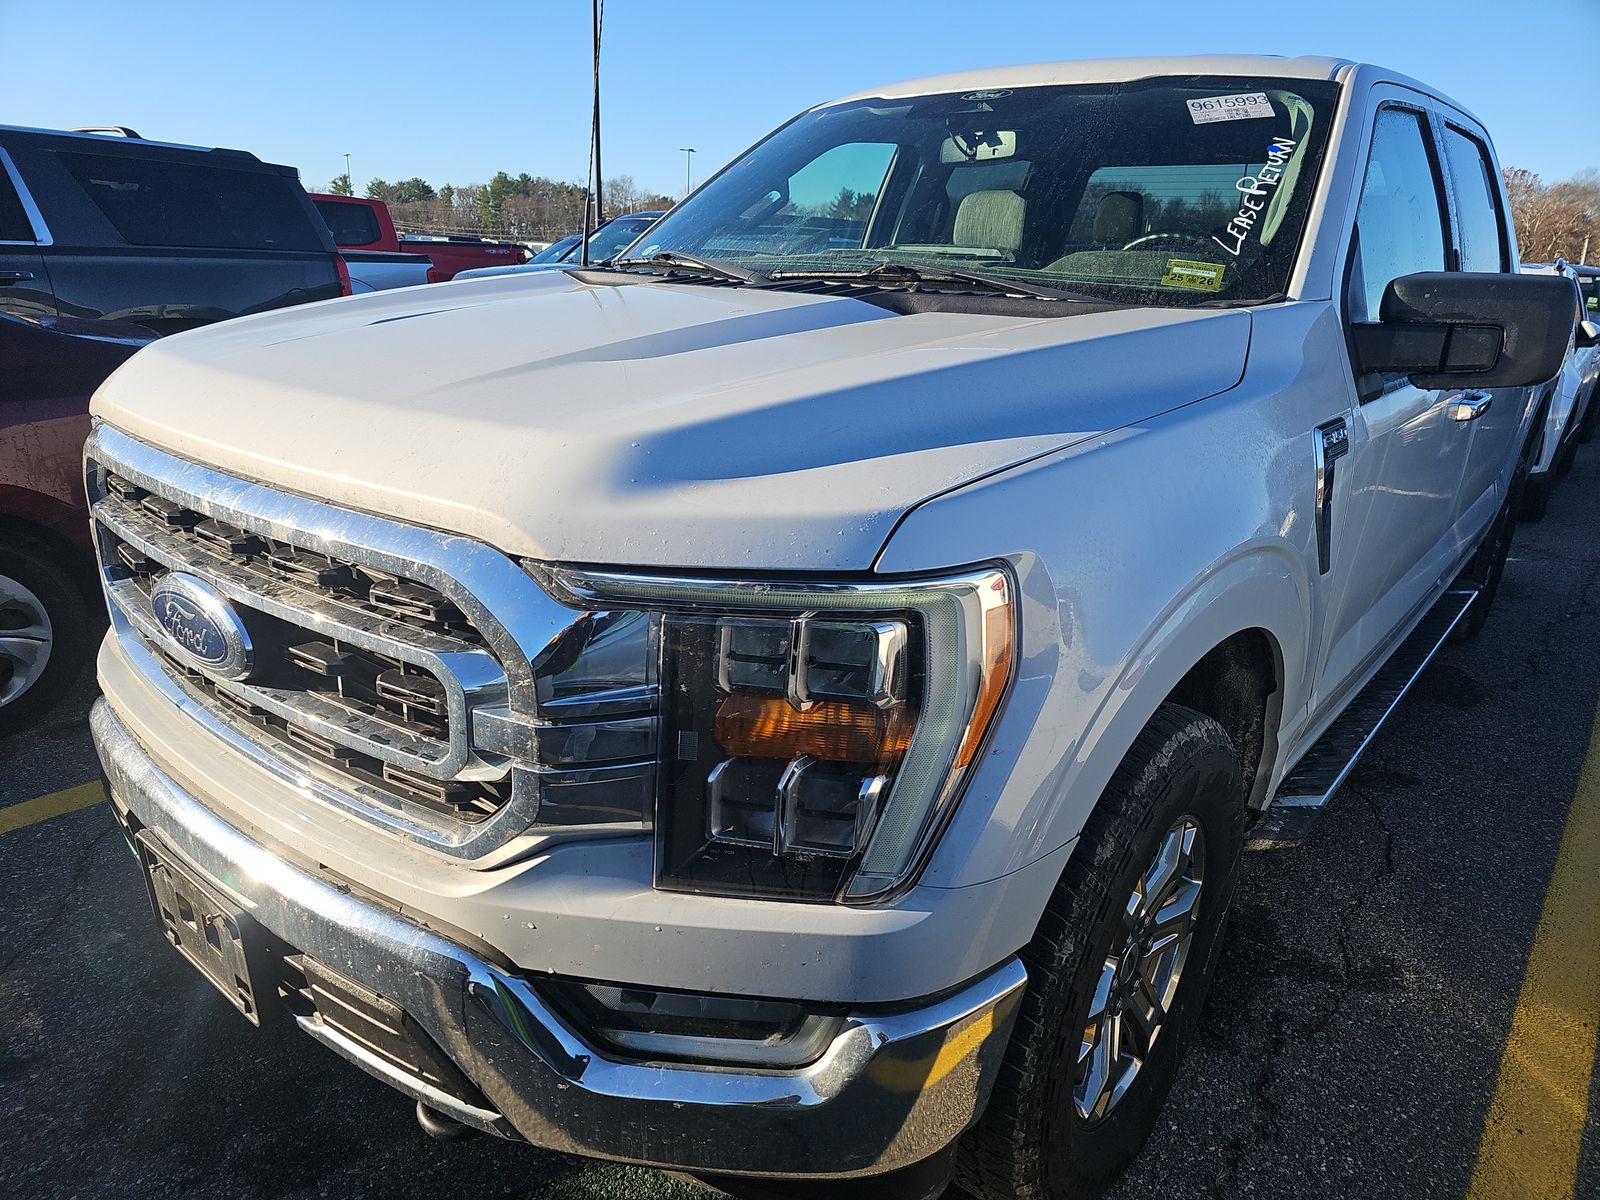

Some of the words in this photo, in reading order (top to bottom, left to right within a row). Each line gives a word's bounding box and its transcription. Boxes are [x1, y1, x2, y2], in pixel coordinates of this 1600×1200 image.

[1191, 95, 1269, 111] 9615993
[1212, 194, 1265, 256] LEASE
[1169, 273, 1184, 282] 25
[1199, 277, 1214, 286] 26
[164, 601, 208, 655] Ford
